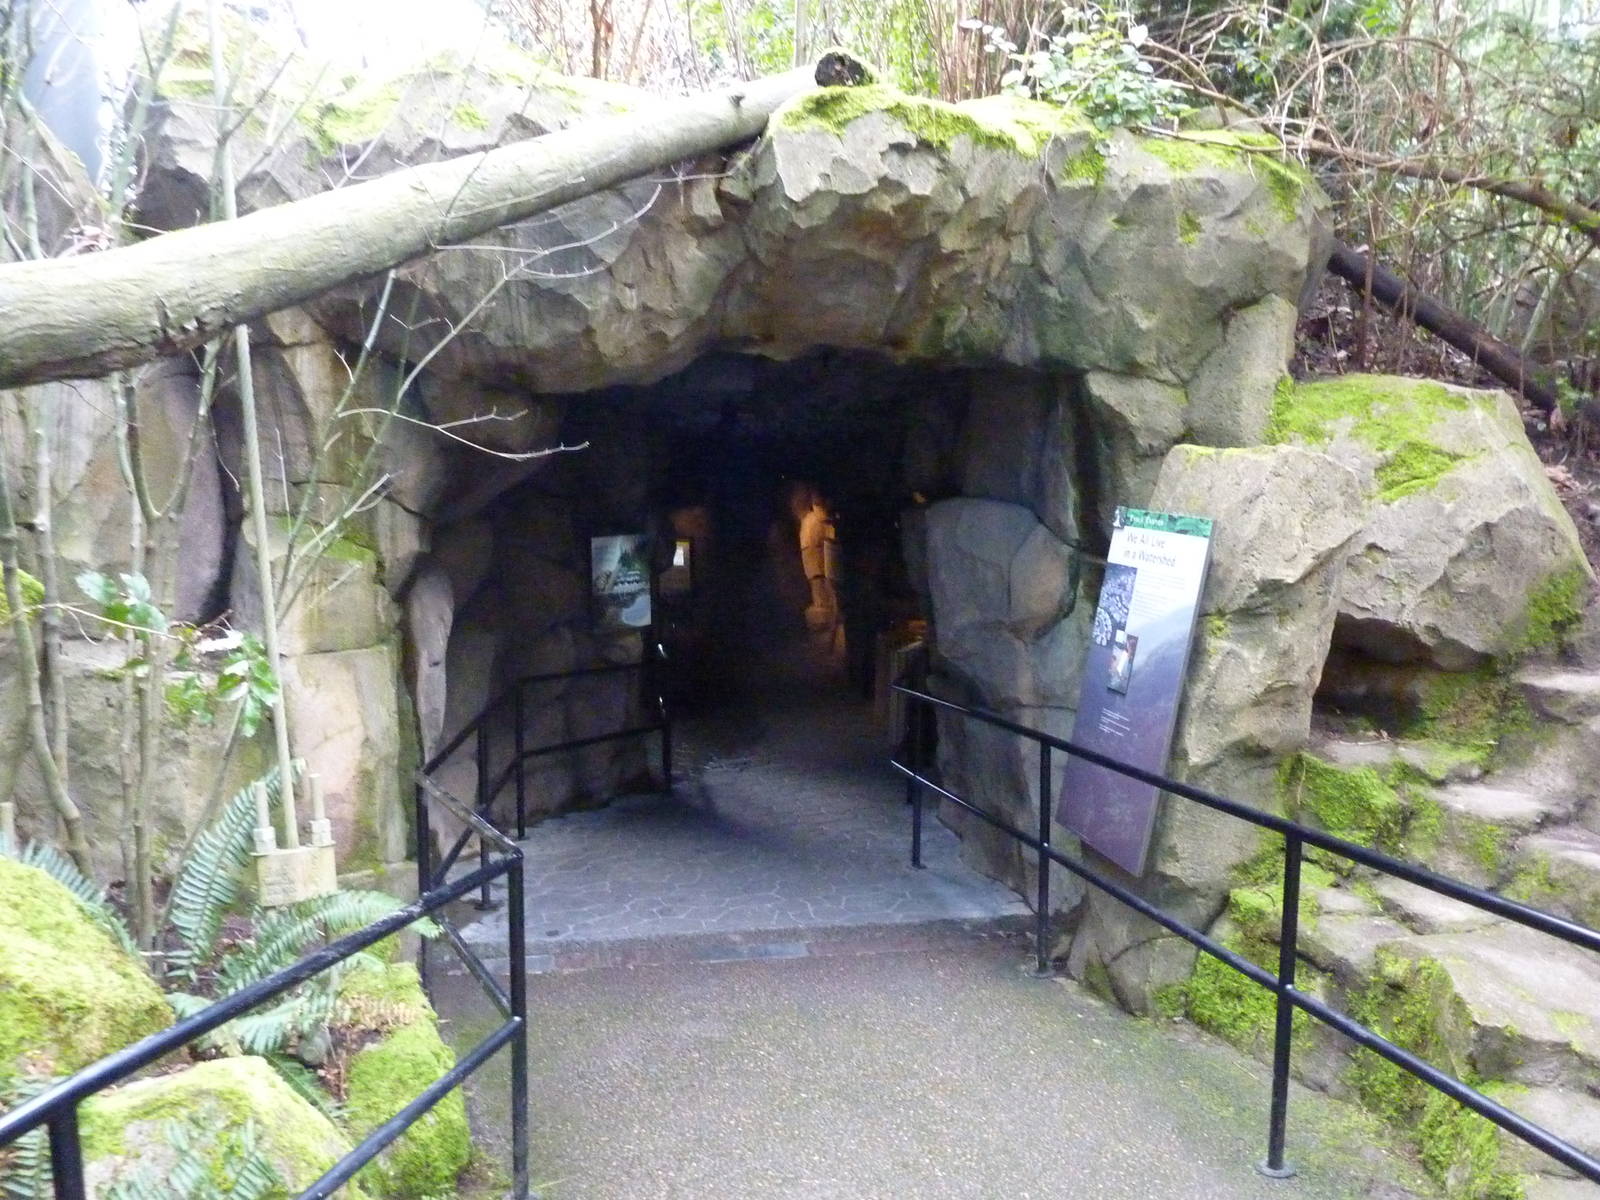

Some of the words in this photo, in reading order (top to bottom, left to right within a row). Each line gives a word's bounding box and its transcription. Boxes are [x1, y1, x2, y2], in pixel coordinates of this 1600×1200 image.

[1127, 531, 1138, 544] We
[1151, 536, 1166, 549] Live
[1138, 550, 1177, 568] Watershed
